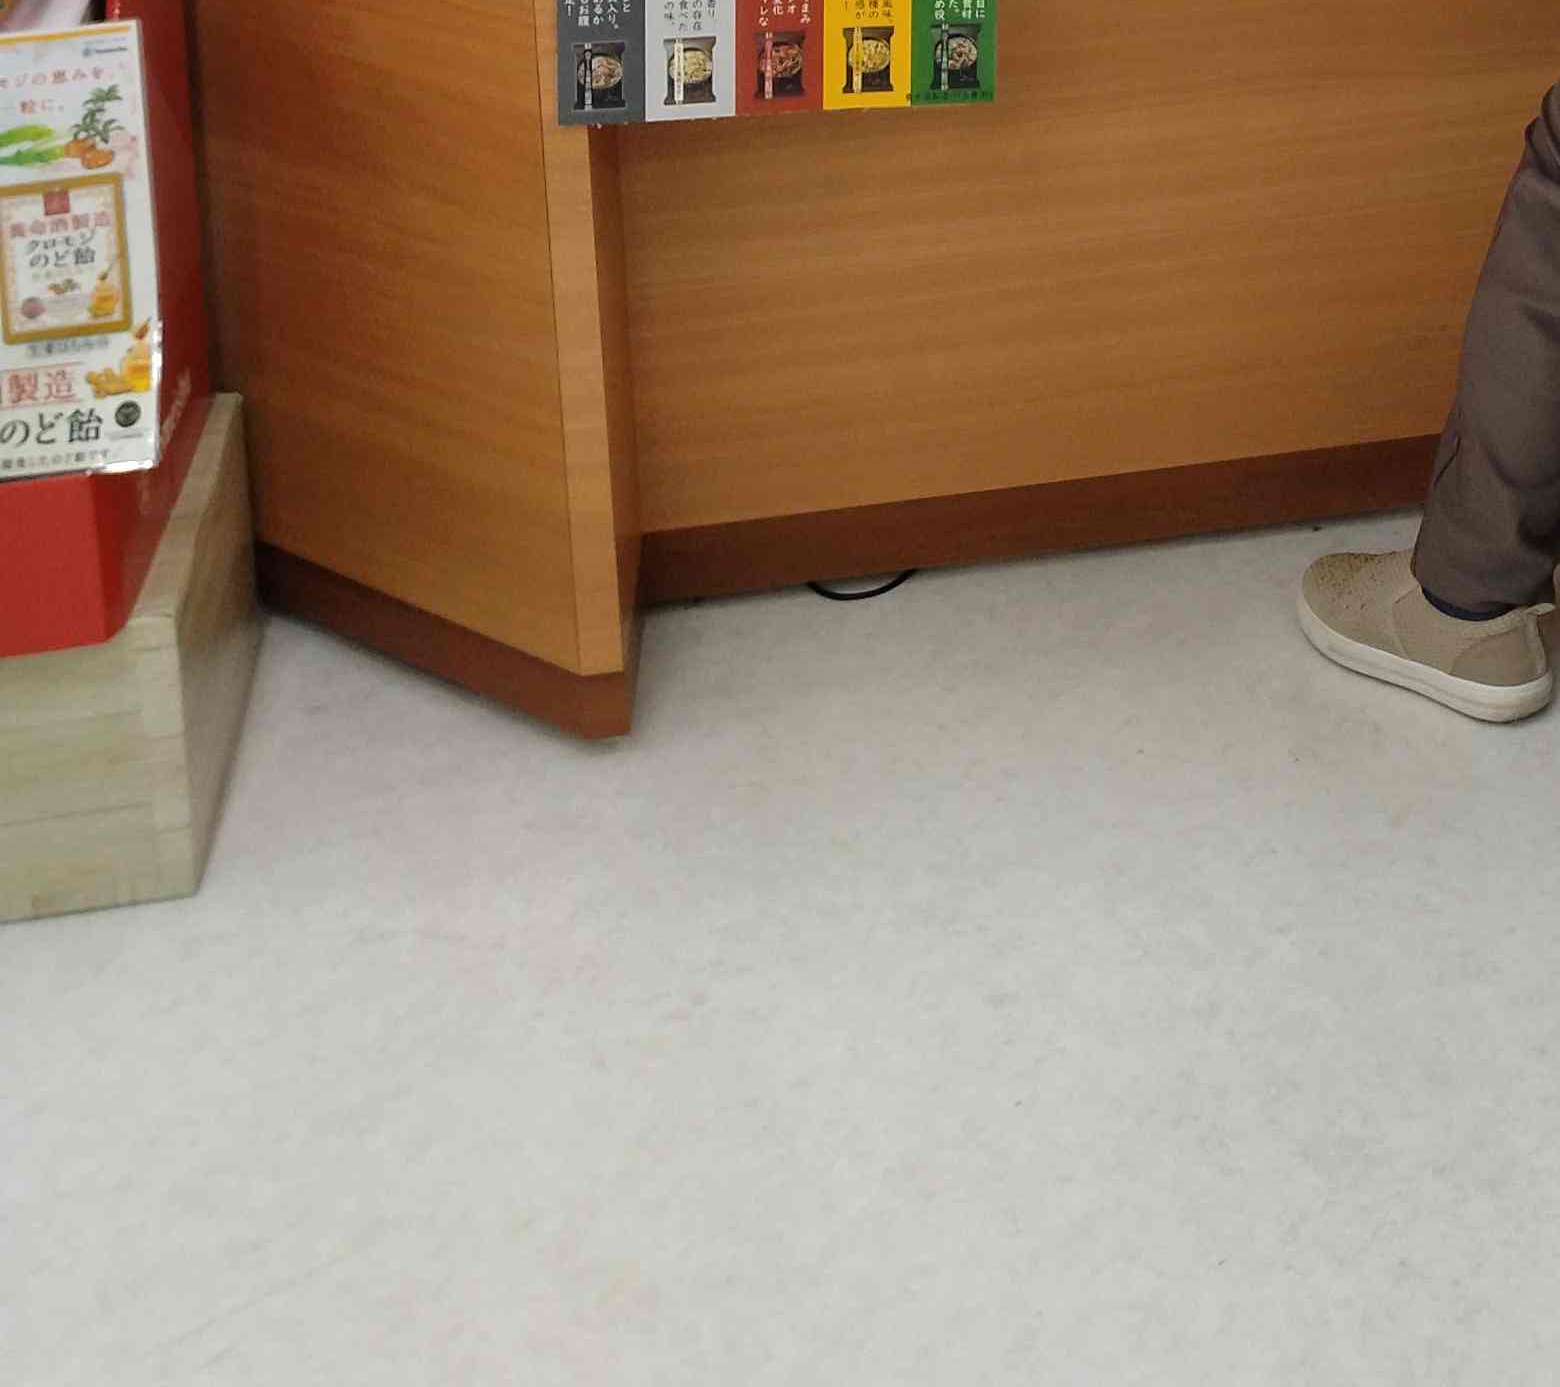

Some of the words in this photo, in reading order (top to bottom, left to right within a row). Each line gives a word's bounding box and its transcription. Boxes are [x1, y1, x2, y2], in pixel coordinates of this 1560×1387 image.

[29, 247, 96, 269] のど飴
[0, 407, 103, 447] のど飴
